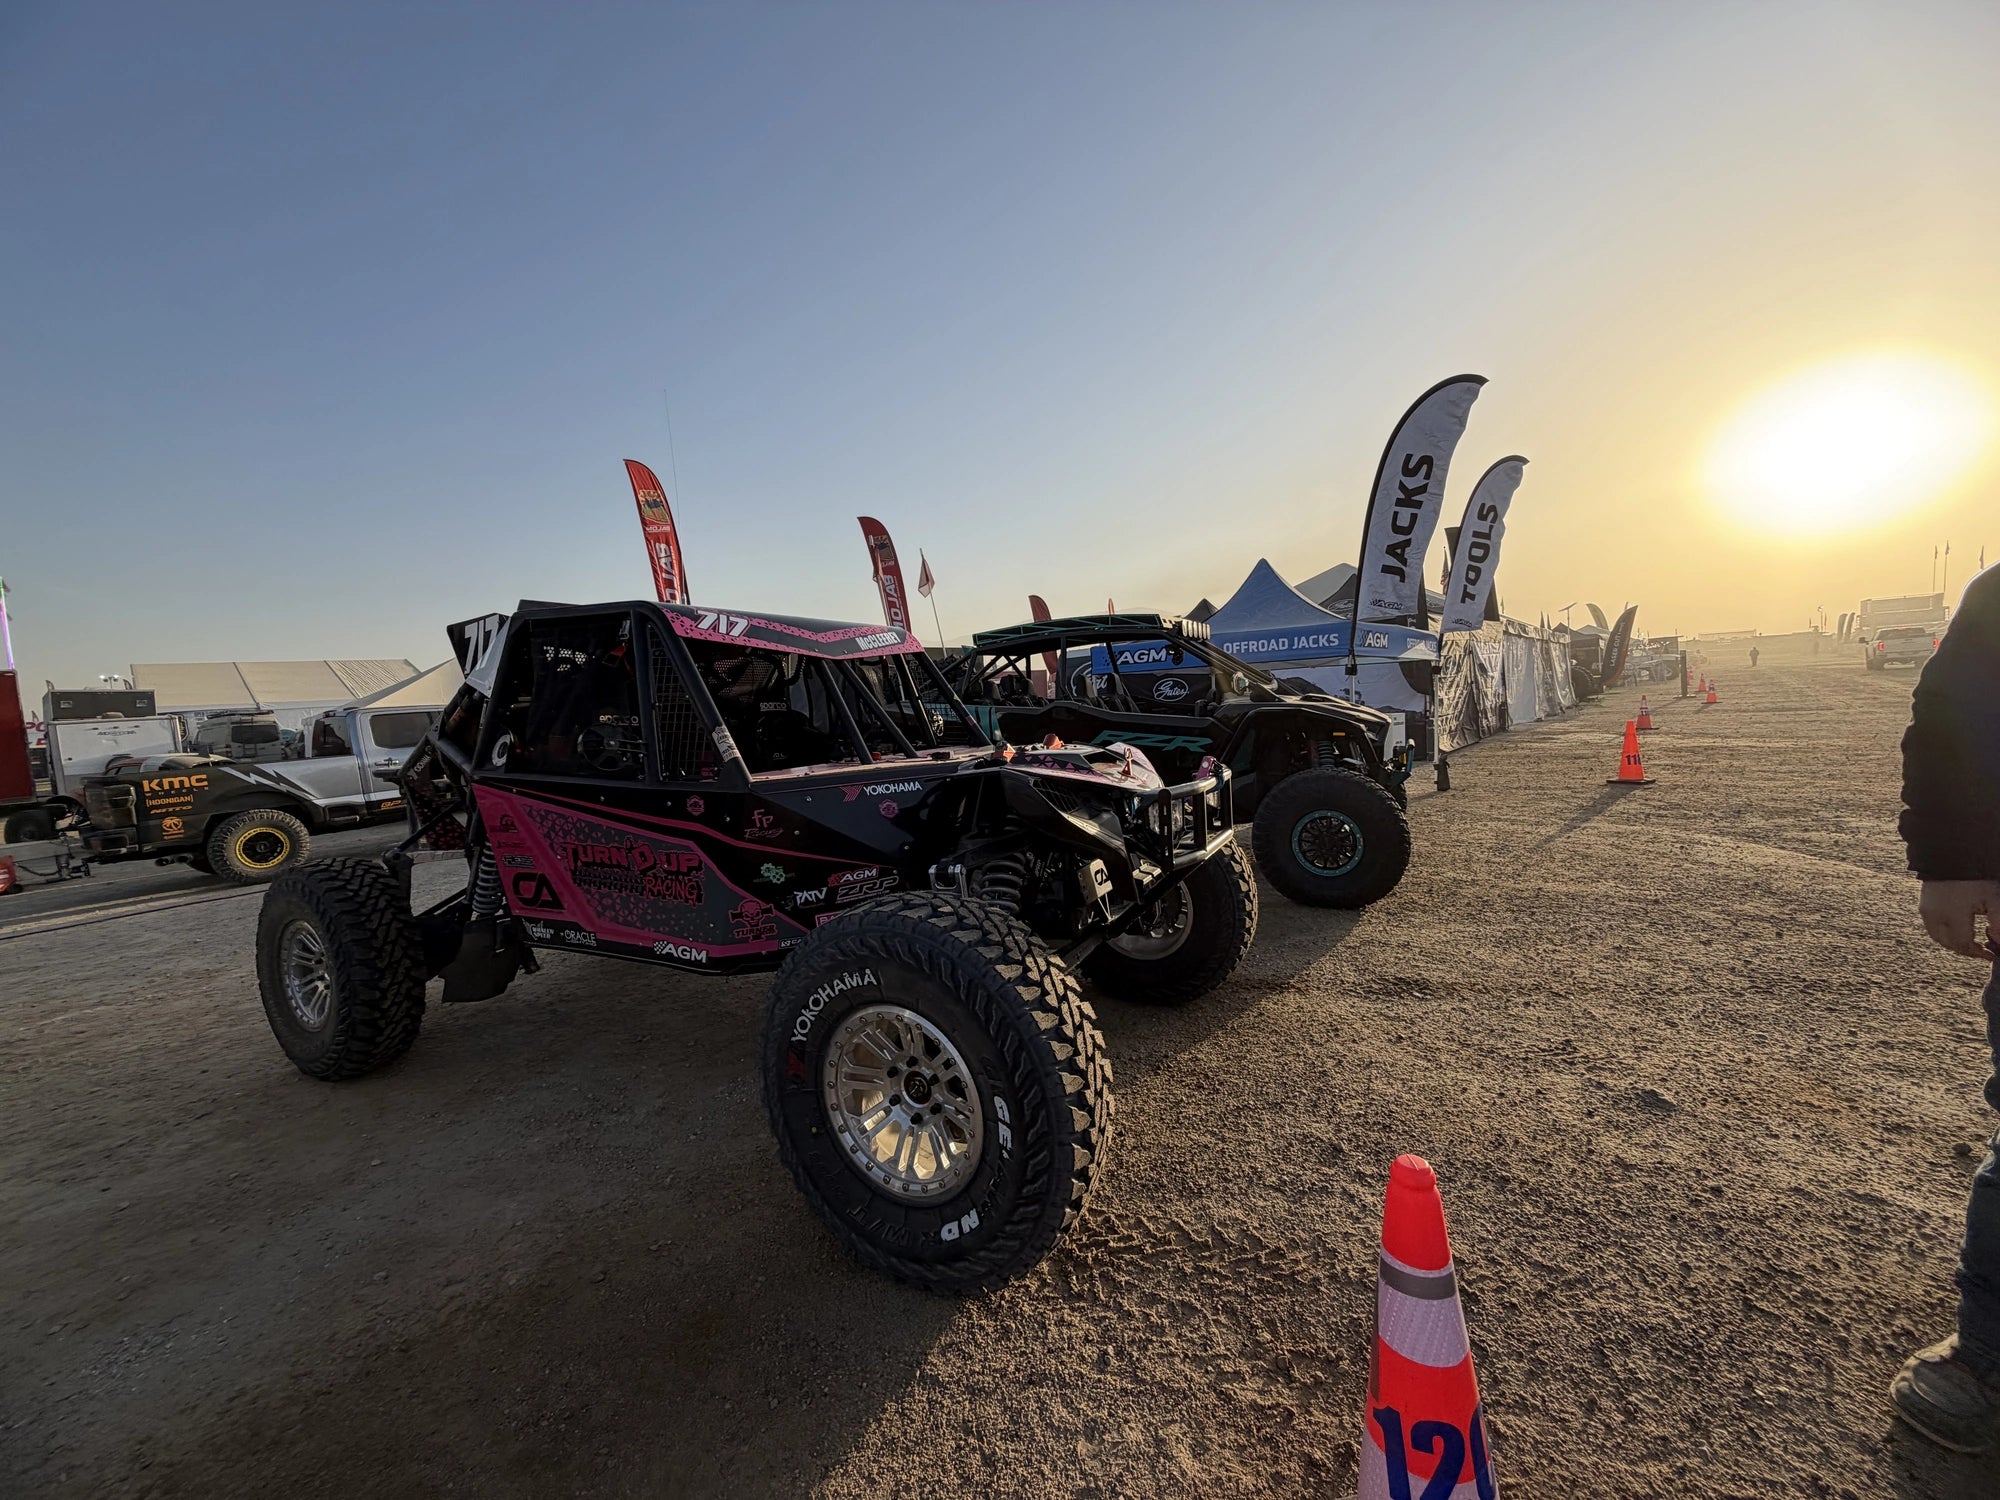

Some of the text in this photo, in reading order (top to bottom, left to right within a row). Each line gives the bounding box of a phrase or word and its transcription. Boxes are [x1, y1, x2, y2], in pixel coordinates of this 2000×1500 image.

[1380, 453, 1434, 584] JACKS
[1460, 502, 1499, 604] TOOLS
[655, 542, 678, 603] OJAB
[1377, 599, 1404, 610] AGM
[696, 609, 749, 637] 717
[464, 614, 500, 675] 717
[1223, 633, 1339, 655] OFFROAD JACKS
[1364, 632, 1389, 649] AGM
[1116, 648, 1167, 665] AGM
[1609, 648, 1618, 667] LASER
[1090, 730, 1214, 753] RZR
[143, 774, 208, 793] KMC
[863, 780, 923, 797] YOKOHAMA
[658, 852, 704, 873] UP
[840, 867, 877, 883] AGM
[643, 874, 704, 904] RACING
[836, 875, 899, 903] ZRP
[564, 929, 597, 944] ORACLE
[662, 942, 708, 964] AGM
[790, 967, 878, 1042] YOKOHAMA
